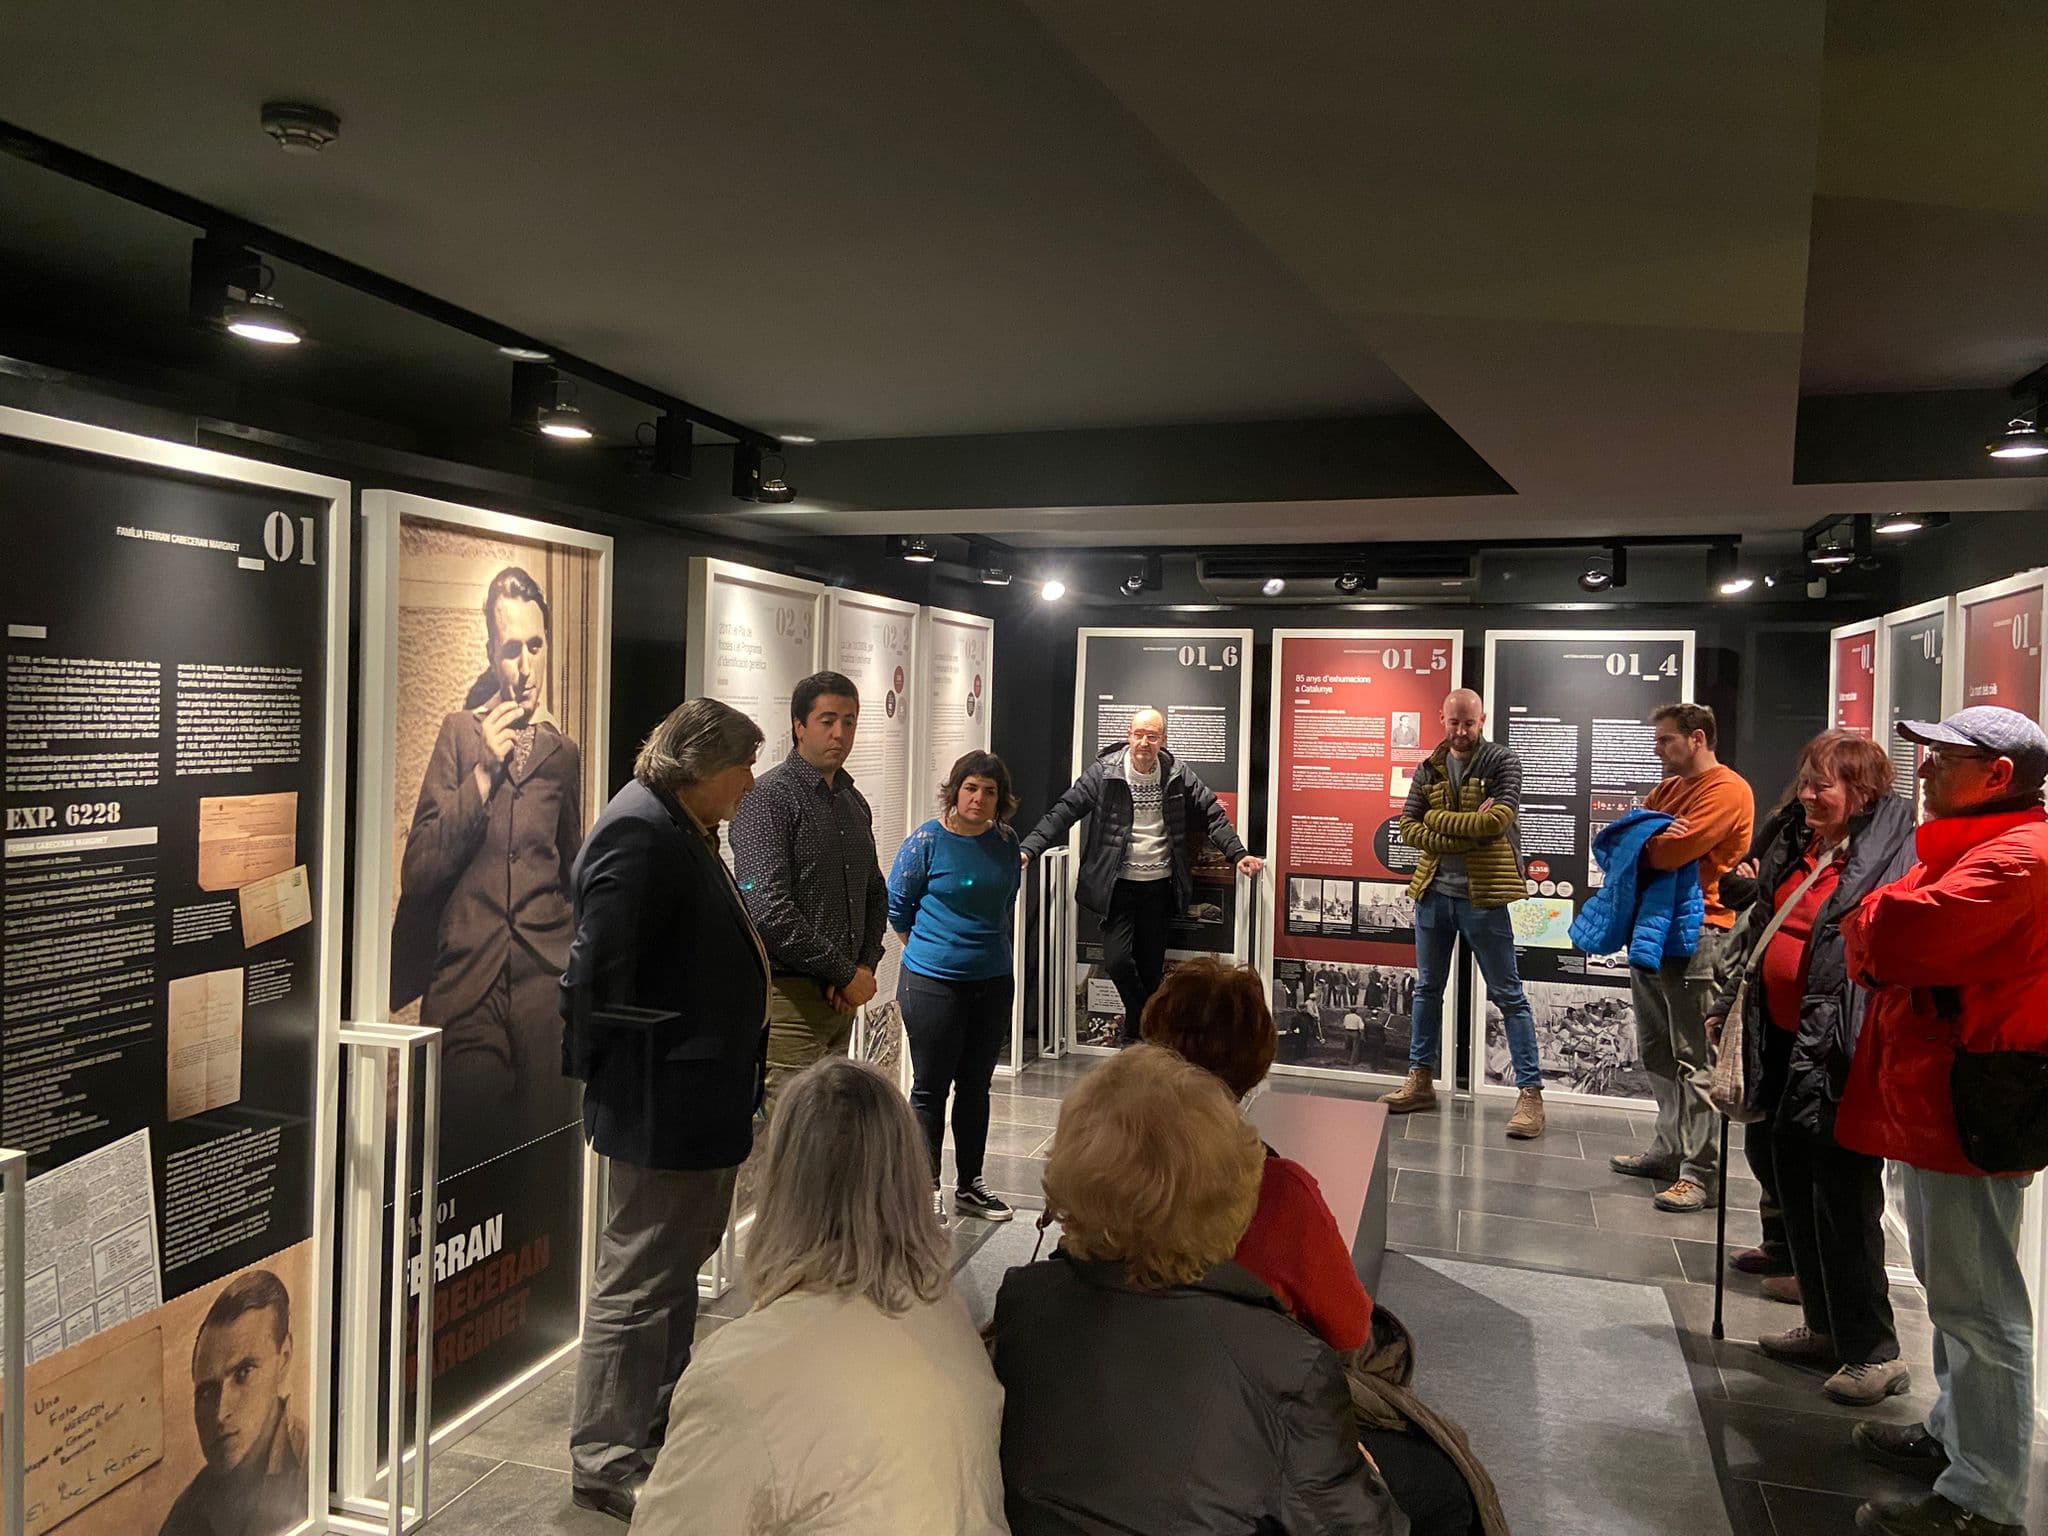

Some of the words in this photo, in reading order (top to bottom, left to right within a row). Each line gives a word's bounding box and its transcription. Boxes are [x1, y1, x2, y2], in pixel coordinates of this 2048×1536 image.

[1178, 645, 1239, 671] 01_6
[1382, 648, 1447, 675] 01_5
[1605, 653, 1679, 681] 01_4
[1295, 674, 1305, 683] 85
[1306, 675, 1321, 684] anys
[1301, 685, 1333, 695] Catalunya
[5, 806, 58, 831] EXP.
[65, 801, 121, 827] 6228
[406, 1213, 503, 1298] ERRAN
